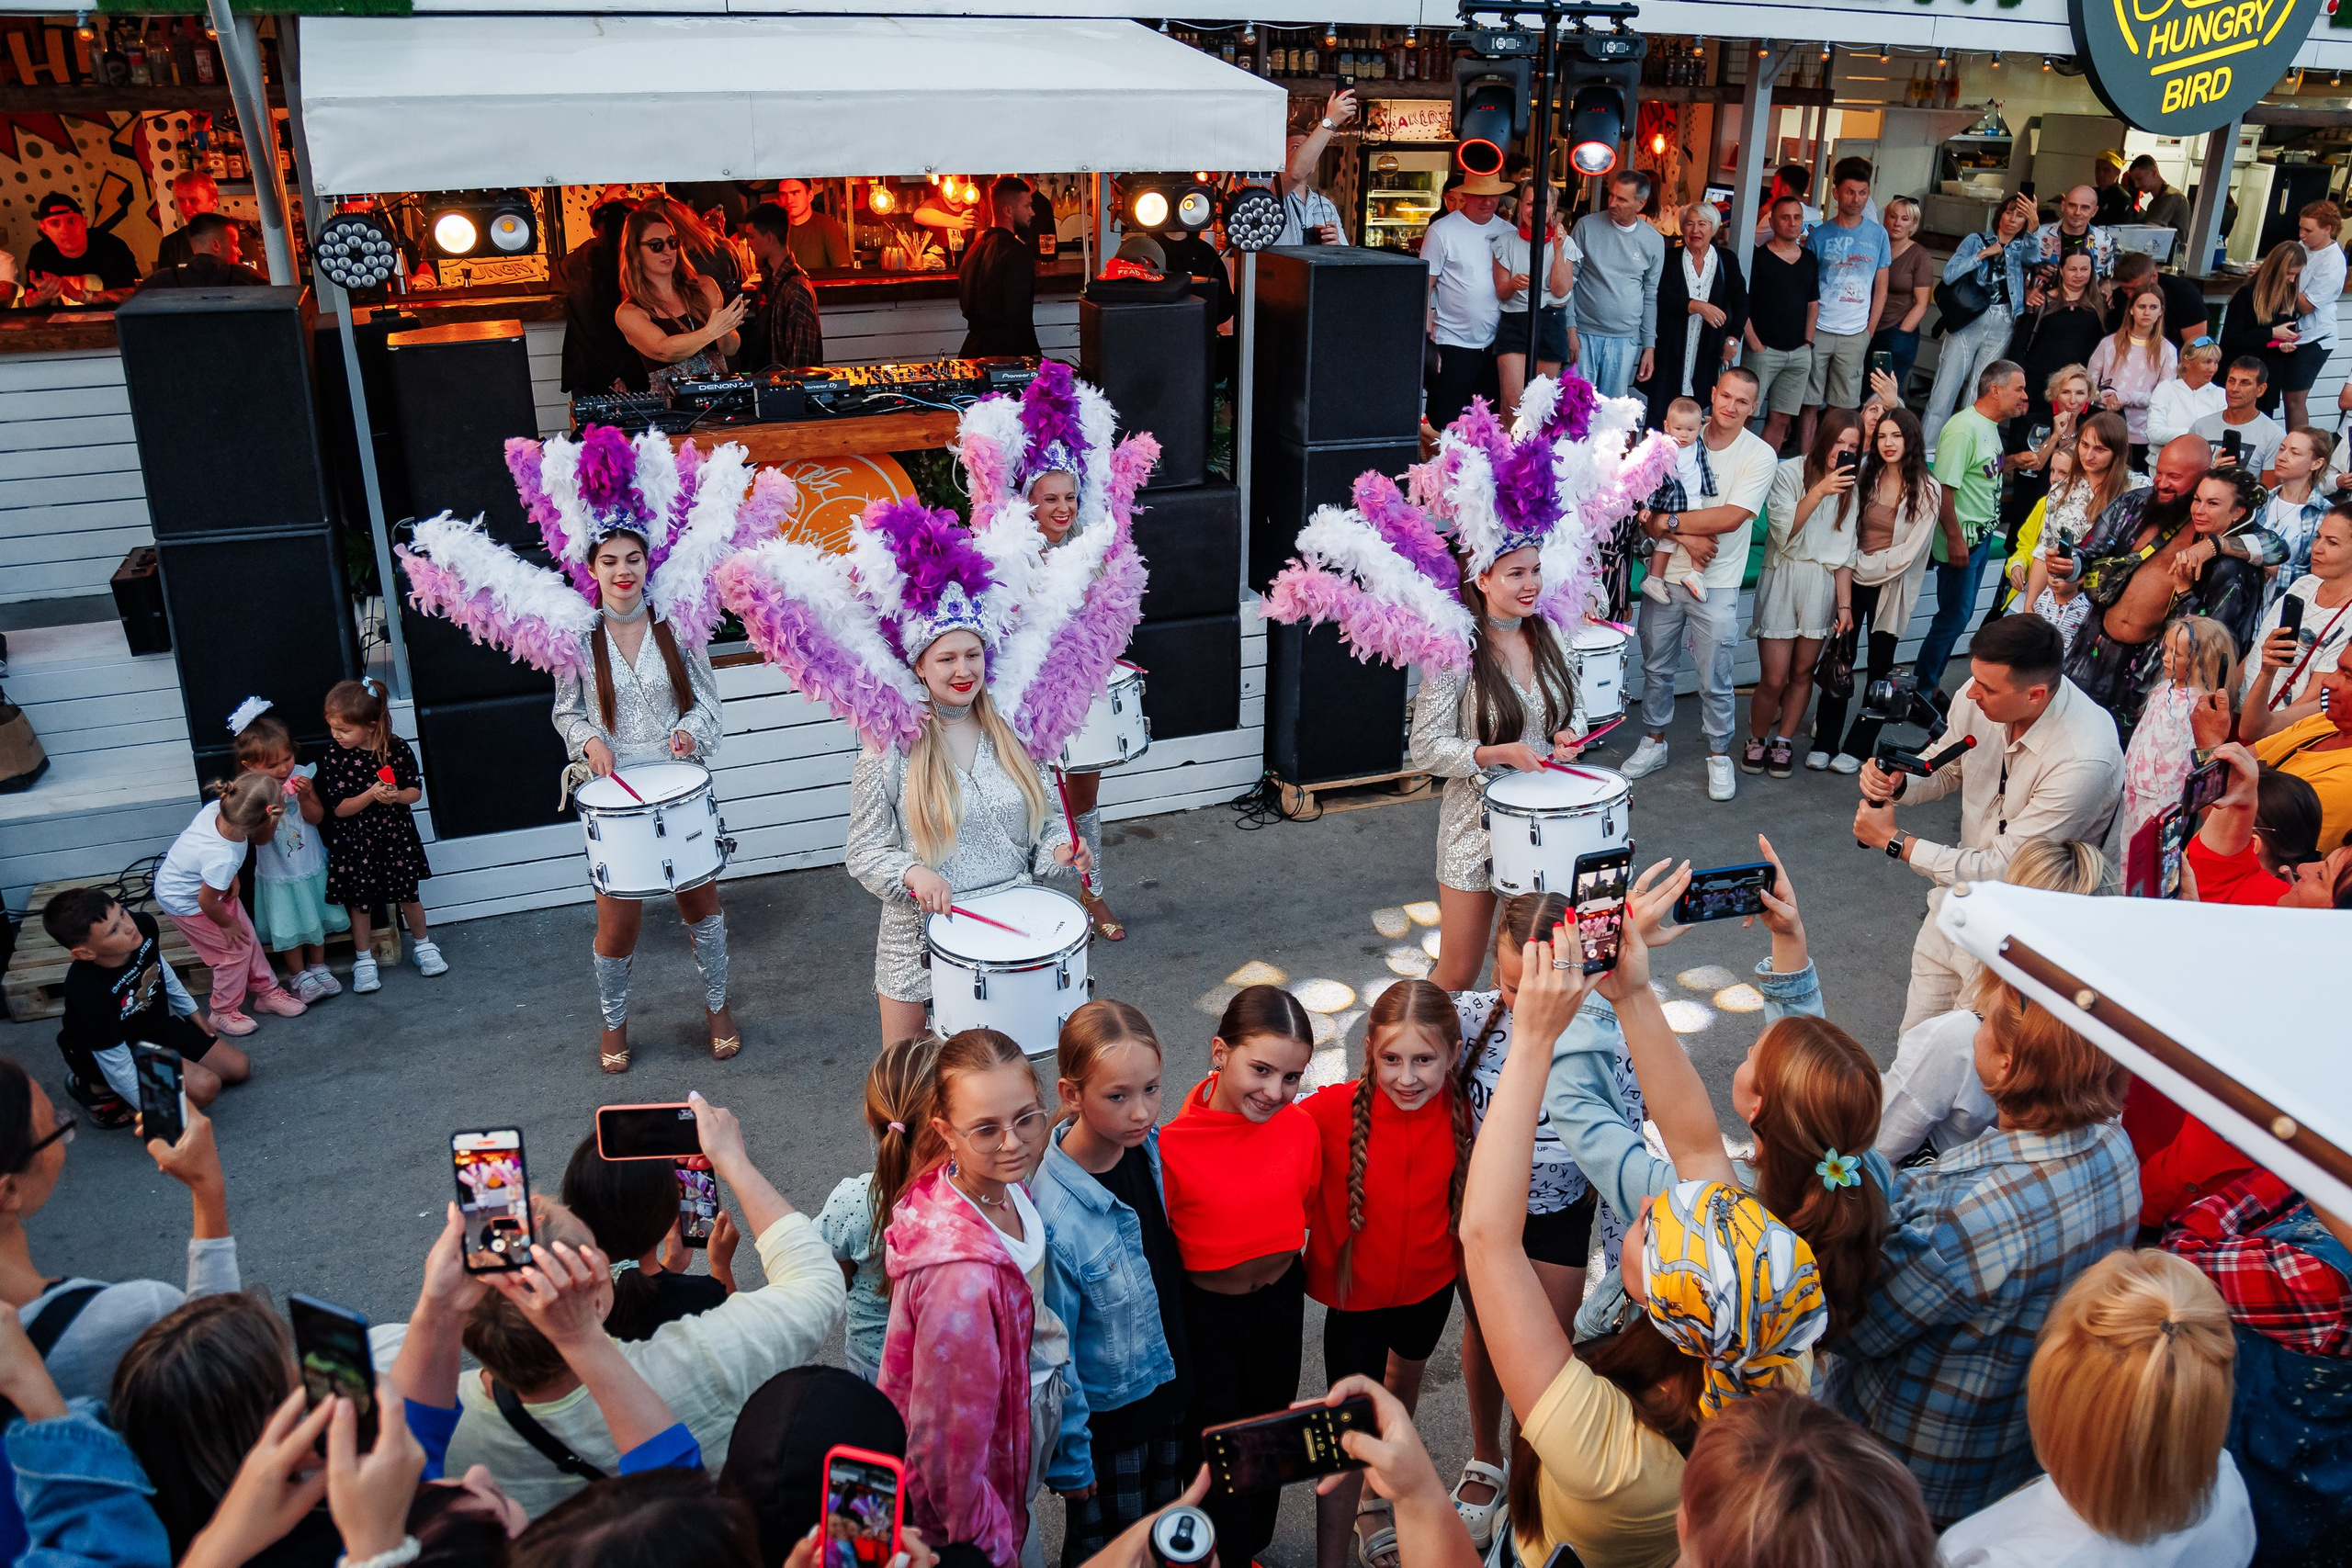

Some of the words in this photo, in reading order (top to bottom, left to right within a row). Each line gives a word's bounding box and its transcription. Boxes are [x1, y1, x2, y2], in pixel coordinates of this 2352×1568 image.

[2146, 1, 2274, 60] HUNGRY
[2161, 65, 2233, 114] BIRD
[698, 382, 738, 390] DENON
